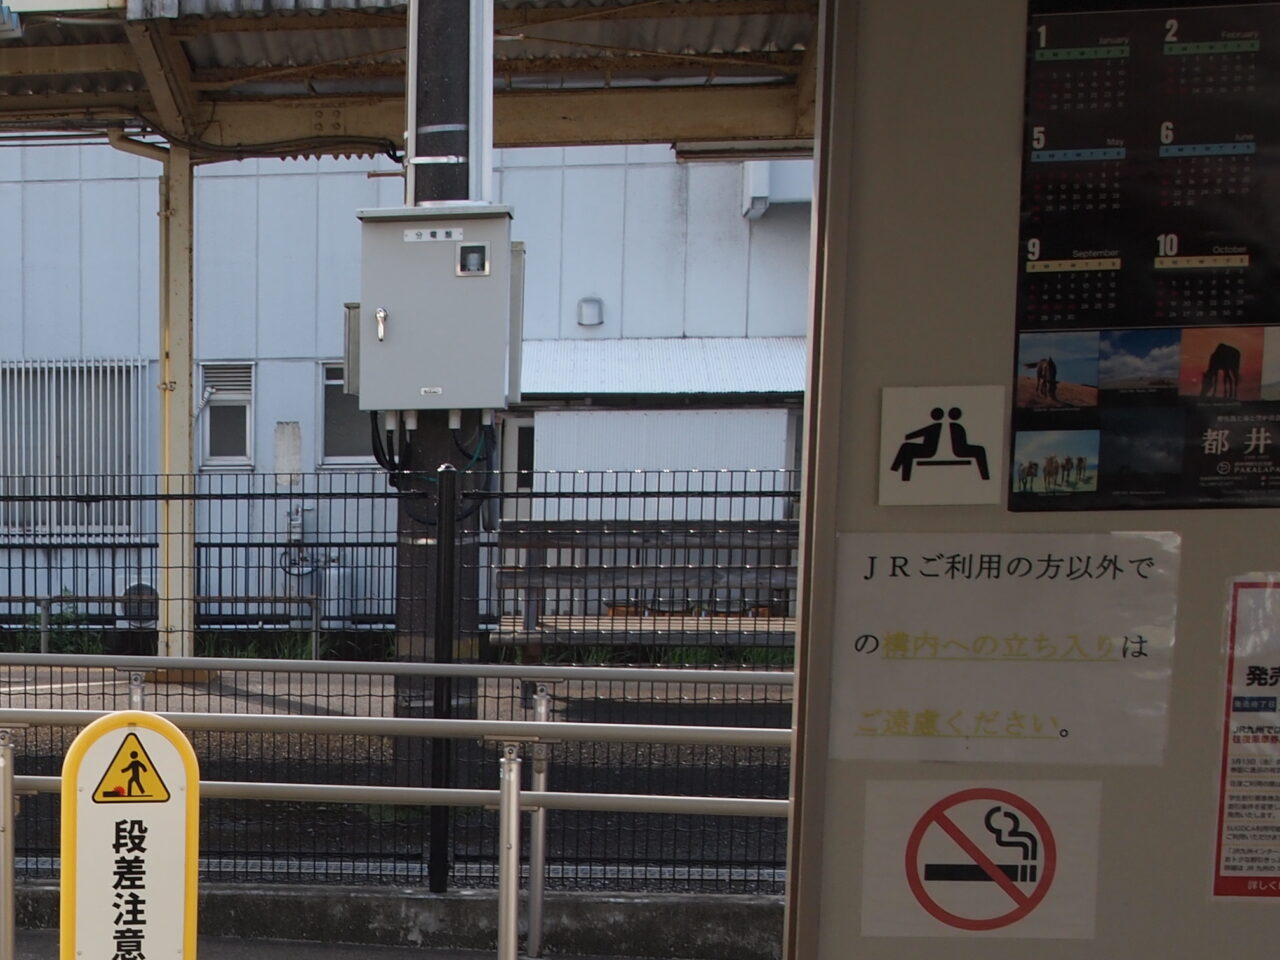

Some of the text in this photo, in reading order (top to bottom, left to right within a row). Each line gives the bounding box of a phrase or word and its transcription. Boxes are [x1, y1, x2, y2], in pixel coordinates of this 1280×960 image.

[1037, 25, 1047, 48] 1
[1164, 19, 1178, 43] 2
[1032, 126, 1125, 149] 5 May
[1160, 121, 1174, 144] 6
[1027, 238, 1120, 261] 9 September
[1157, 234, 1248, 257] 10 October
[863, 553, 1155, 580] JRご利用の方以外で
[854, 630, 1149, 661] の構内への立ち入りは
[856, 708, 1069, 739] ご遠慮ください。
